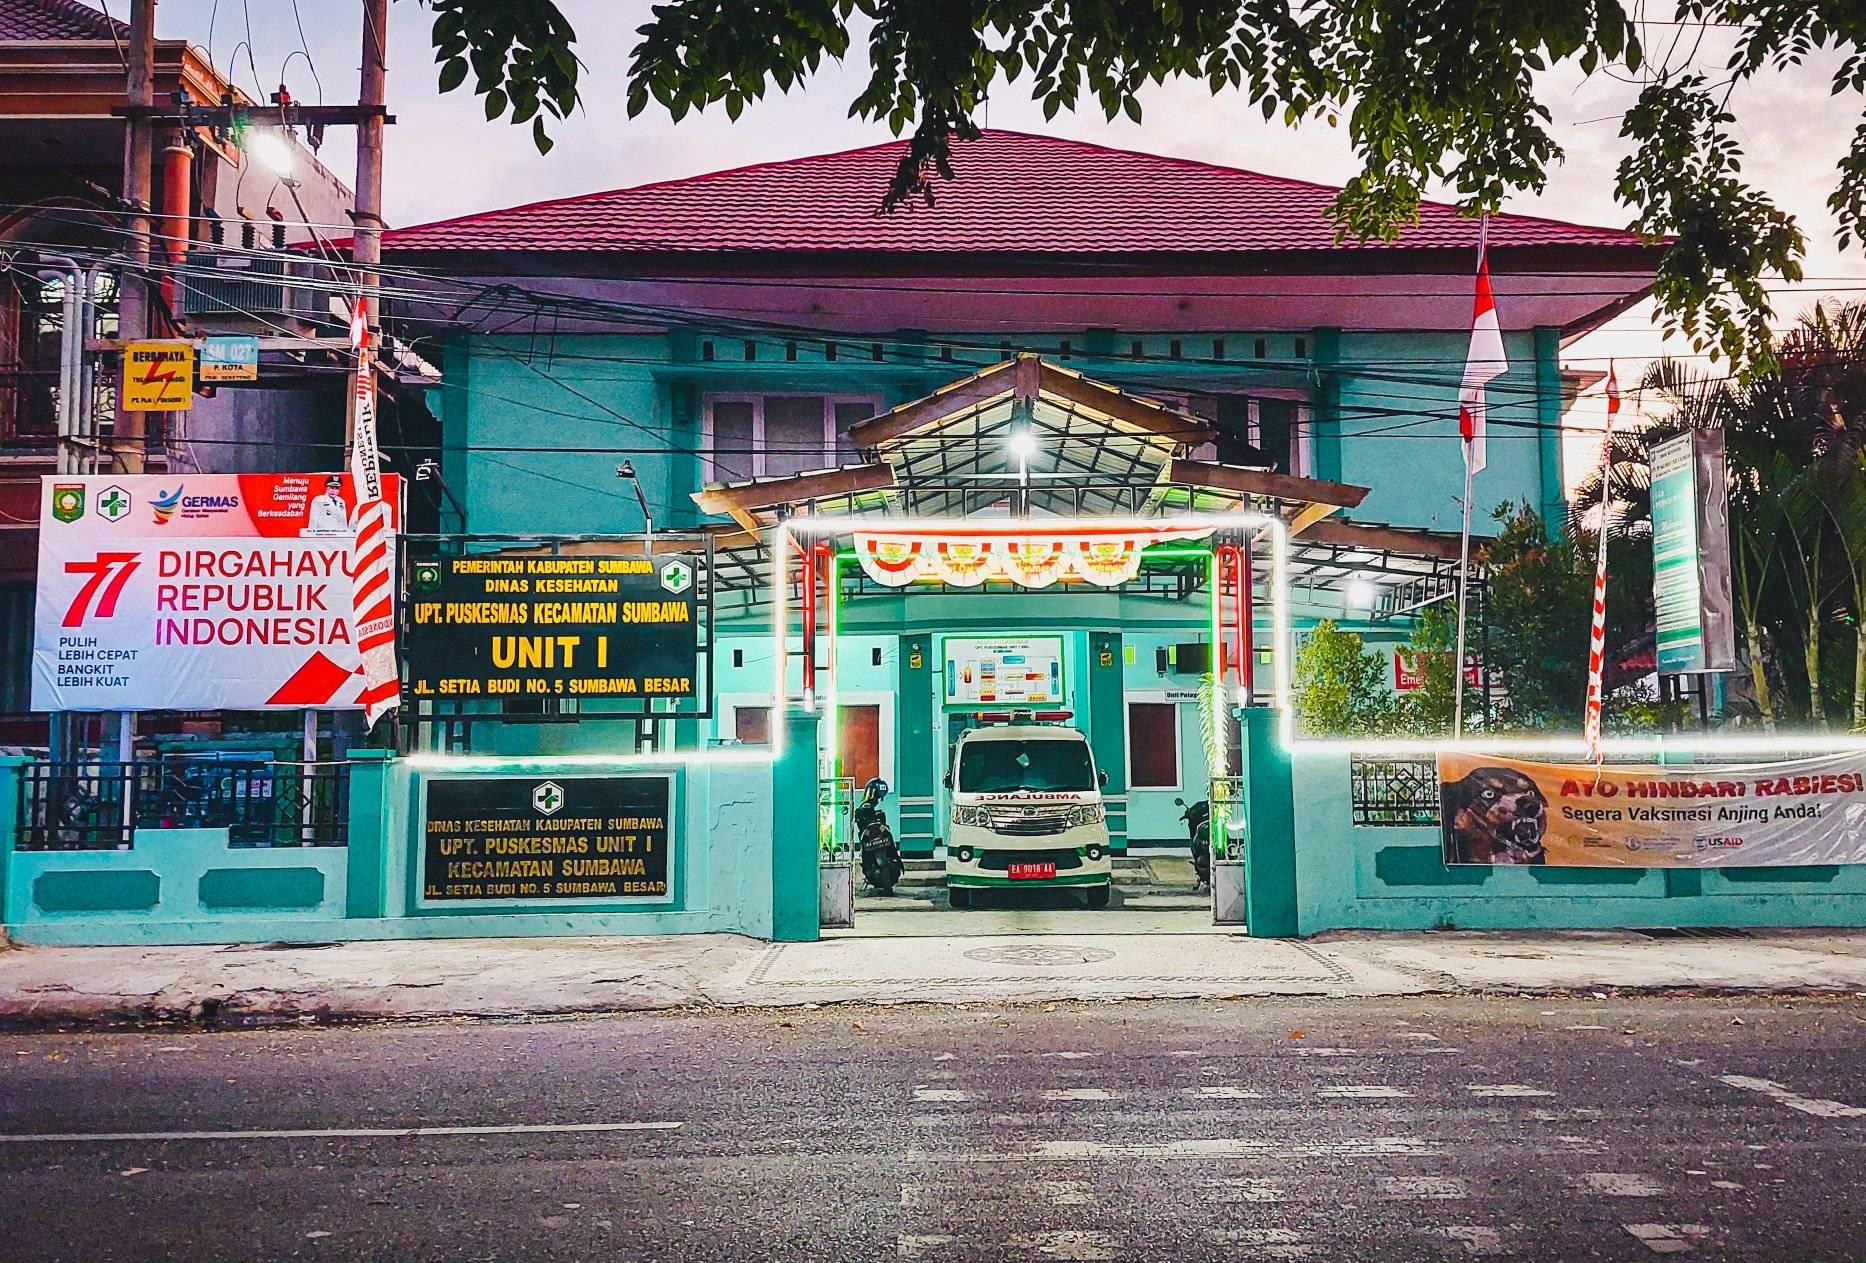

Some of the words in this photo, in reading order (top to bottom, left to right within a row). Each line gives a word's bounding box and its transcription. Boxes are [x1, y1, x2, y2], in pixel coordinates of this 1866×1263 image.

[283, 476, 310, 486] Menuju
[273, 485, 308, 493] Sumbawa
[181, 496, 239, 508] GERMAS
[272, 494, 307, 503] Gemilang
[287, 503, 306, 511] yang
[452, 560, 524, 574] PEMERINTAH
[527, 560, 594, 574] KABUPATEN
[598, 560, 654, 574] SUMBAWA
[61, 552, 143, 628] 77
[485, 580, 529, 593] DINAS
[535, 579, 619, 593] KESEHATAN
[157, 584, 328, 612] REPUBLIK
[414, 603, 443, 624] UPT.
[446, 603, 528, 624] PUSKESMAS
[533, 602, 617, 624] KECAMATAN
[622, 602, 689, 622] SUMBAWA
[155, 618, 351, 646] INDONESIA
[59, 637, 98, 648] PULIH
[58, 650, 95, 660] LEBIH
[97, 650, 139, 660] CEPAT
[491, 636, 580, 668] UNIT
[597, 636, 607, 668] I
[57, 664, 114, 675] BANGKIT
[57, 676, 94, 687] LEBIH
[96, 676, 130, 687] KUAT
[414, 680, 435, 695] JL.
[439, 679, 480, 693] SETIA
[487, 679, 520, 693] BUDI
[526, 679, 550, 693] NO.
[554, 679, 563, 693] 5
[569, 678, 637, 693] SUMBAWA
[644, 678, 690, 692] BESAR
[1560, 779, 1619, 798] AYO
[1626, 780, 1746, 799] HINDARI
[1561, 806, 1622, 825] Segera
[1627, 805, 1712, 821] Vaksinasi
[1717, 805, 1769, 824] Anjing
[427, 820, 461, 833] DINAS
[465, 819, 531, 833] KESEHATAN
[535, 818, 602, 831] KABUPATEN
[607, 817, 664, 830] SUMBAWA
[440, 838, 478, 855] UPT.
[485, 837, 587, 854] PUSKESMAS
[596, 835, 637, 852] UNIT
[646, 835, 652, 852] I
[1708, 837, 1744, 847] USAID
[448, 860, 553, 879] KECAMATAN
[562, 858, 646, 877] SUMBAWA
[425, 884, 442, 896] JL.
[446, 883, 482, 895] SETIA
[486, 883, 516, 895] BUDI
[520, 883, 540, 894] NO.
[543, 883, 550, 894] 5
[556, 882, 617, 894] SUMBAWA
[623, 881, 665, 893] BESAR
